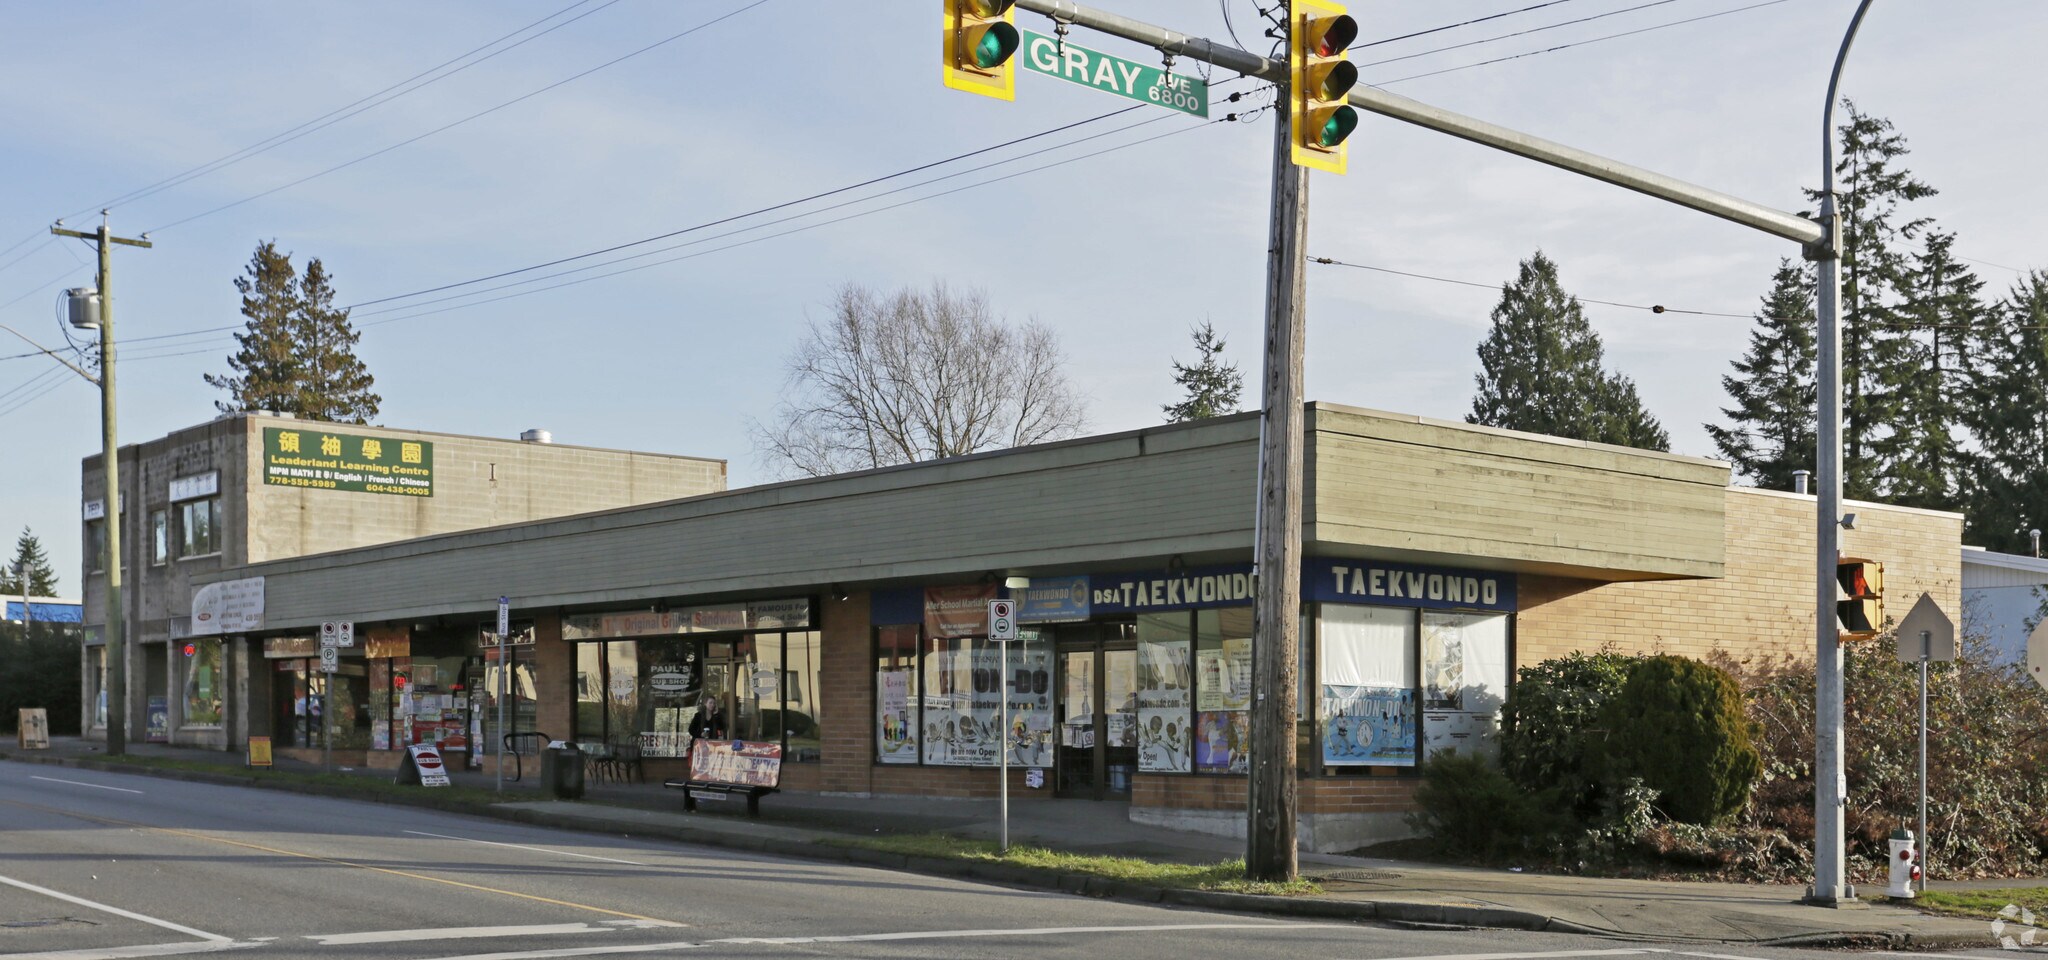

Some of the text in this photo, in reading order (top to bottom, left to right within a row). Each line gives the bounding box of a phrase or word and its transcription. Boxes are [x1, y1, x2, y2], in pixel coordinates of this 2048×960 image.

[1030, 38, 1142, 94] GRAY
[1156, 73, 1191, 94] AVE
[1148, 86, 1198, 111] 6800
[271, 455, 336, 469] Leaderland
[340, 461, 389, 475] Learning
[392, 465, 429, 476] Centre
[270, 466, 288, 475] MPM
[290, 468, 314, 478] MATH
[334, 472, 362, 482] English
[368, 475, 394, 484] French
[400, 478, 429, 487] Chinese
[270, 476, 429, 495] 778-558-5989 604-438-0005
[1029, 588, 1069, 601] TAEKWONDO
[1332, 566, 1496, 605] TAEKWONDO
[941, 600, 961, 609] School
[1094, 589, 1120, 604] DSA
[758, 604, 793, 612] FAMOUS
[651, 665, 689, 673] PAUL'S
